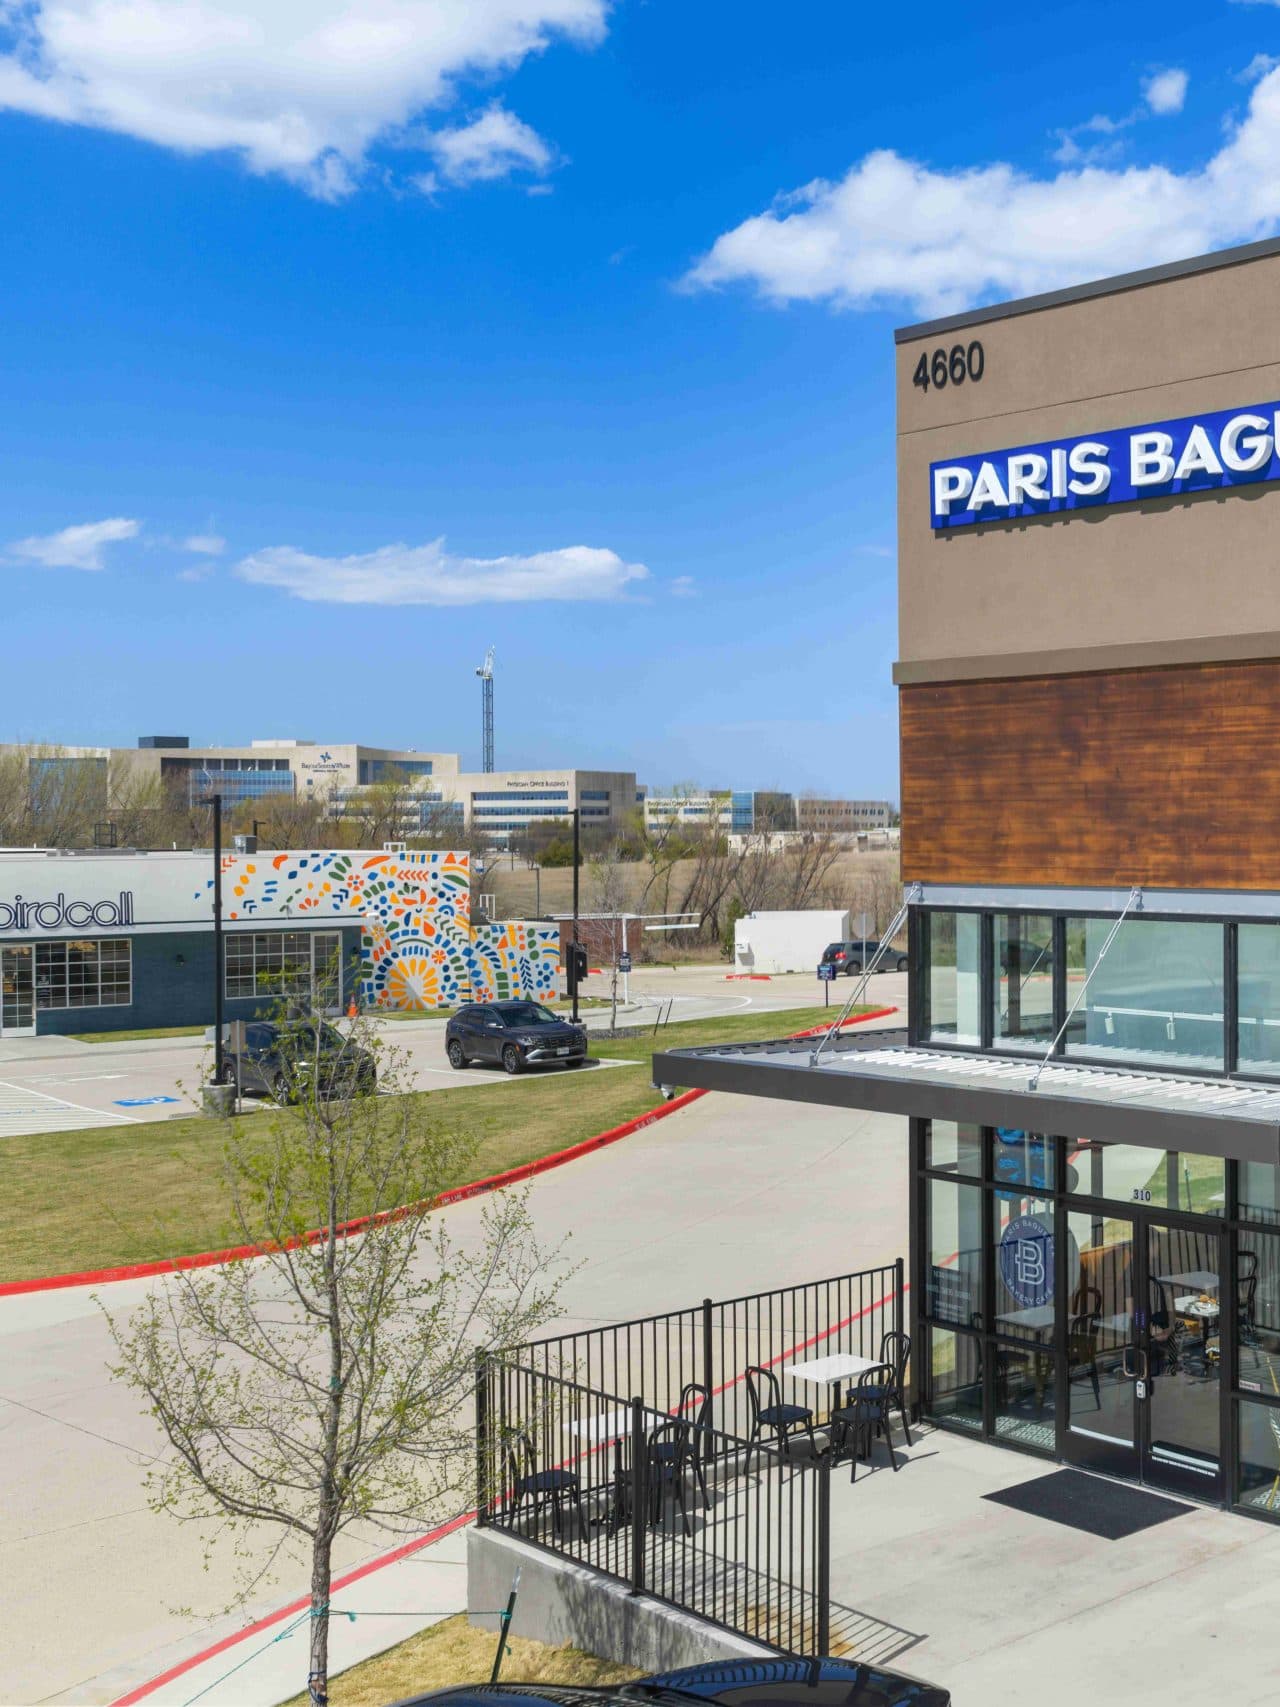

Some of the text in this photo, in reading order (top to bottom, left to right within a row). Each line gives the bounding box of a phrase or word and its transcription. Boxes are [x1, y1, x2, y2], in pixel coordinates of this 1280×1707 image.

[913, 341, 984, 393] 4660
[934, 442, 1111, 515] PARIS
[1133, 1189, 1151, 1201] 310
